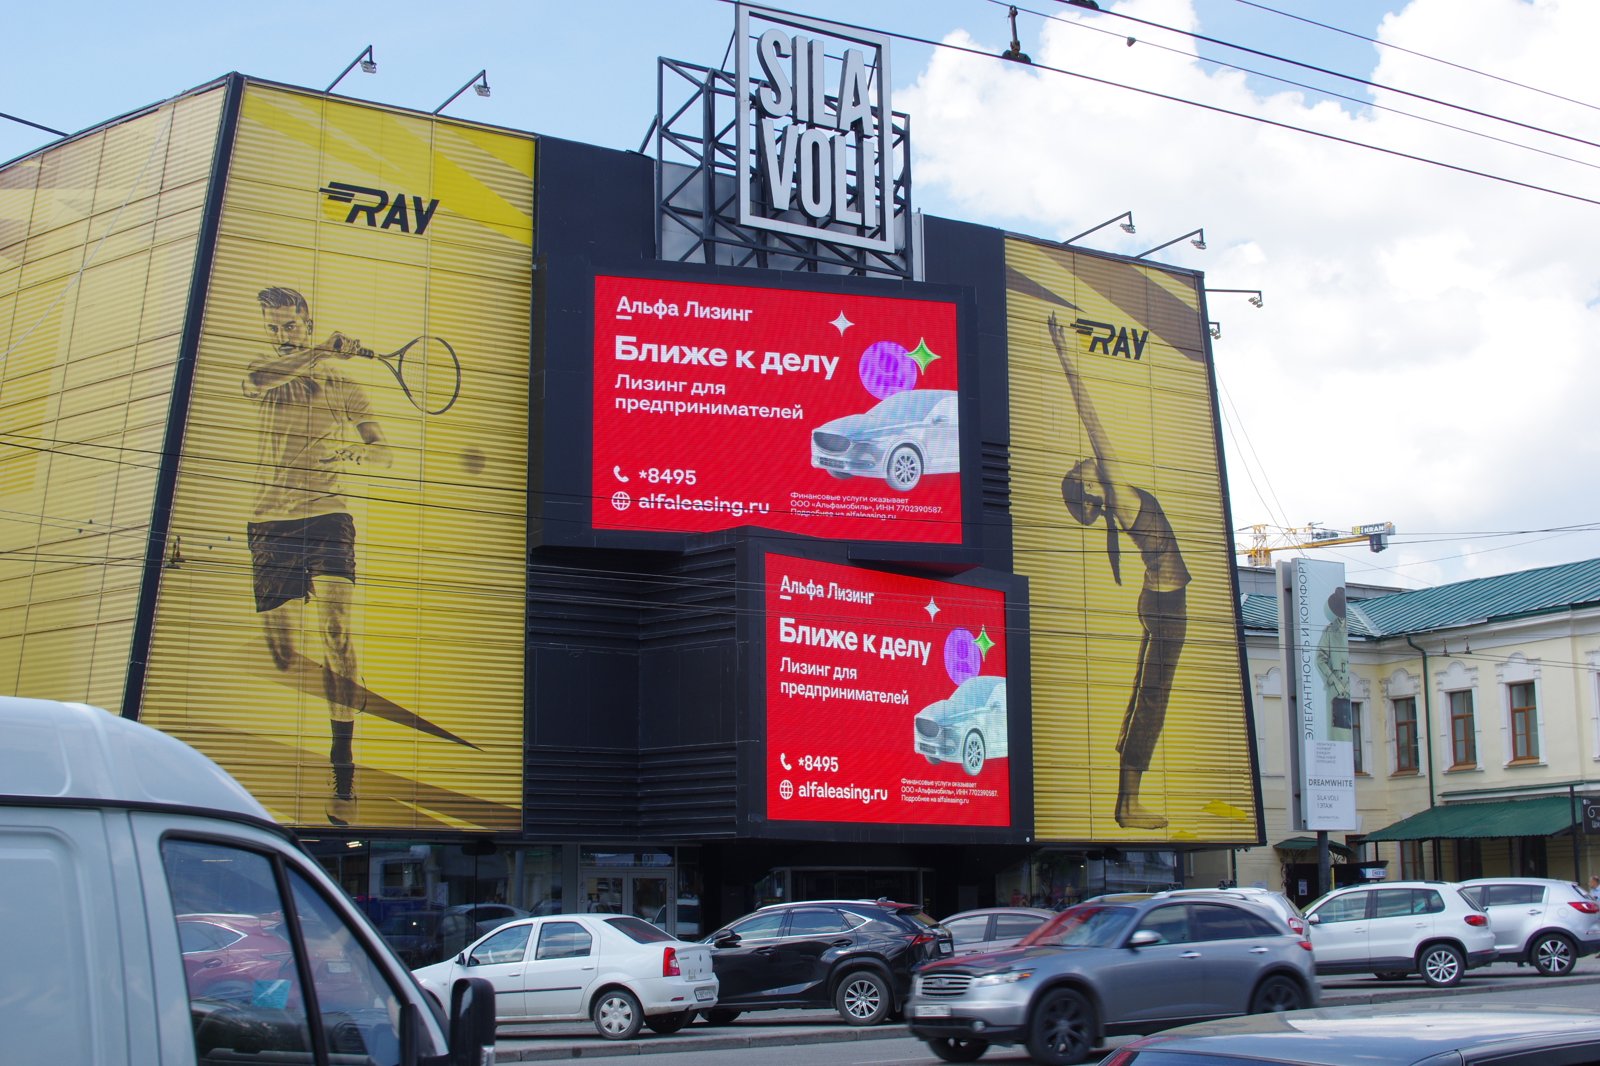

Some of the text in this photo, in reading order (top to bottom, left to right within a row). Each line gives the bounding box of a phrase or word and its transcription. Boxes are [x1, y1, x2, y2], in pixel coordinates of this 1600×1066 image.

[757, 28, 875, 138] SILA
[759, 117, 876, 228] VOLI
[616, 296, 752, 321] Альфа Лизинг
[615, 335, 840, 380] Ближе к делу
[615, 374, 726, 396] Лизинг для
[615, 397, 804, 420] предпринимателей
[638, 493, 769, 517] alfaleasing.ru
[790, 492, 909, 504] Финансовые услуги оказывает
[790, 500, 810, 508] ООО
[876, 504, 895, 512] ИНН
[896, 505, 943, 514] 7702390587.
[780, 575, 874, 604] Альфа Лизинг
[780, 617, 932, 666] Ближе к делу
[1298, 559, 1314, 740] ЭЛЕГАНТНОСТЬ И КОМФОРТ
[780, 657, 858, 680] Лизинг для
[780, 682, 909, 705] предпринимателей
[798, 781, 888, 804] alfaleasing.ru
[1308, 779, 1353, 787] DREAMWHITE
